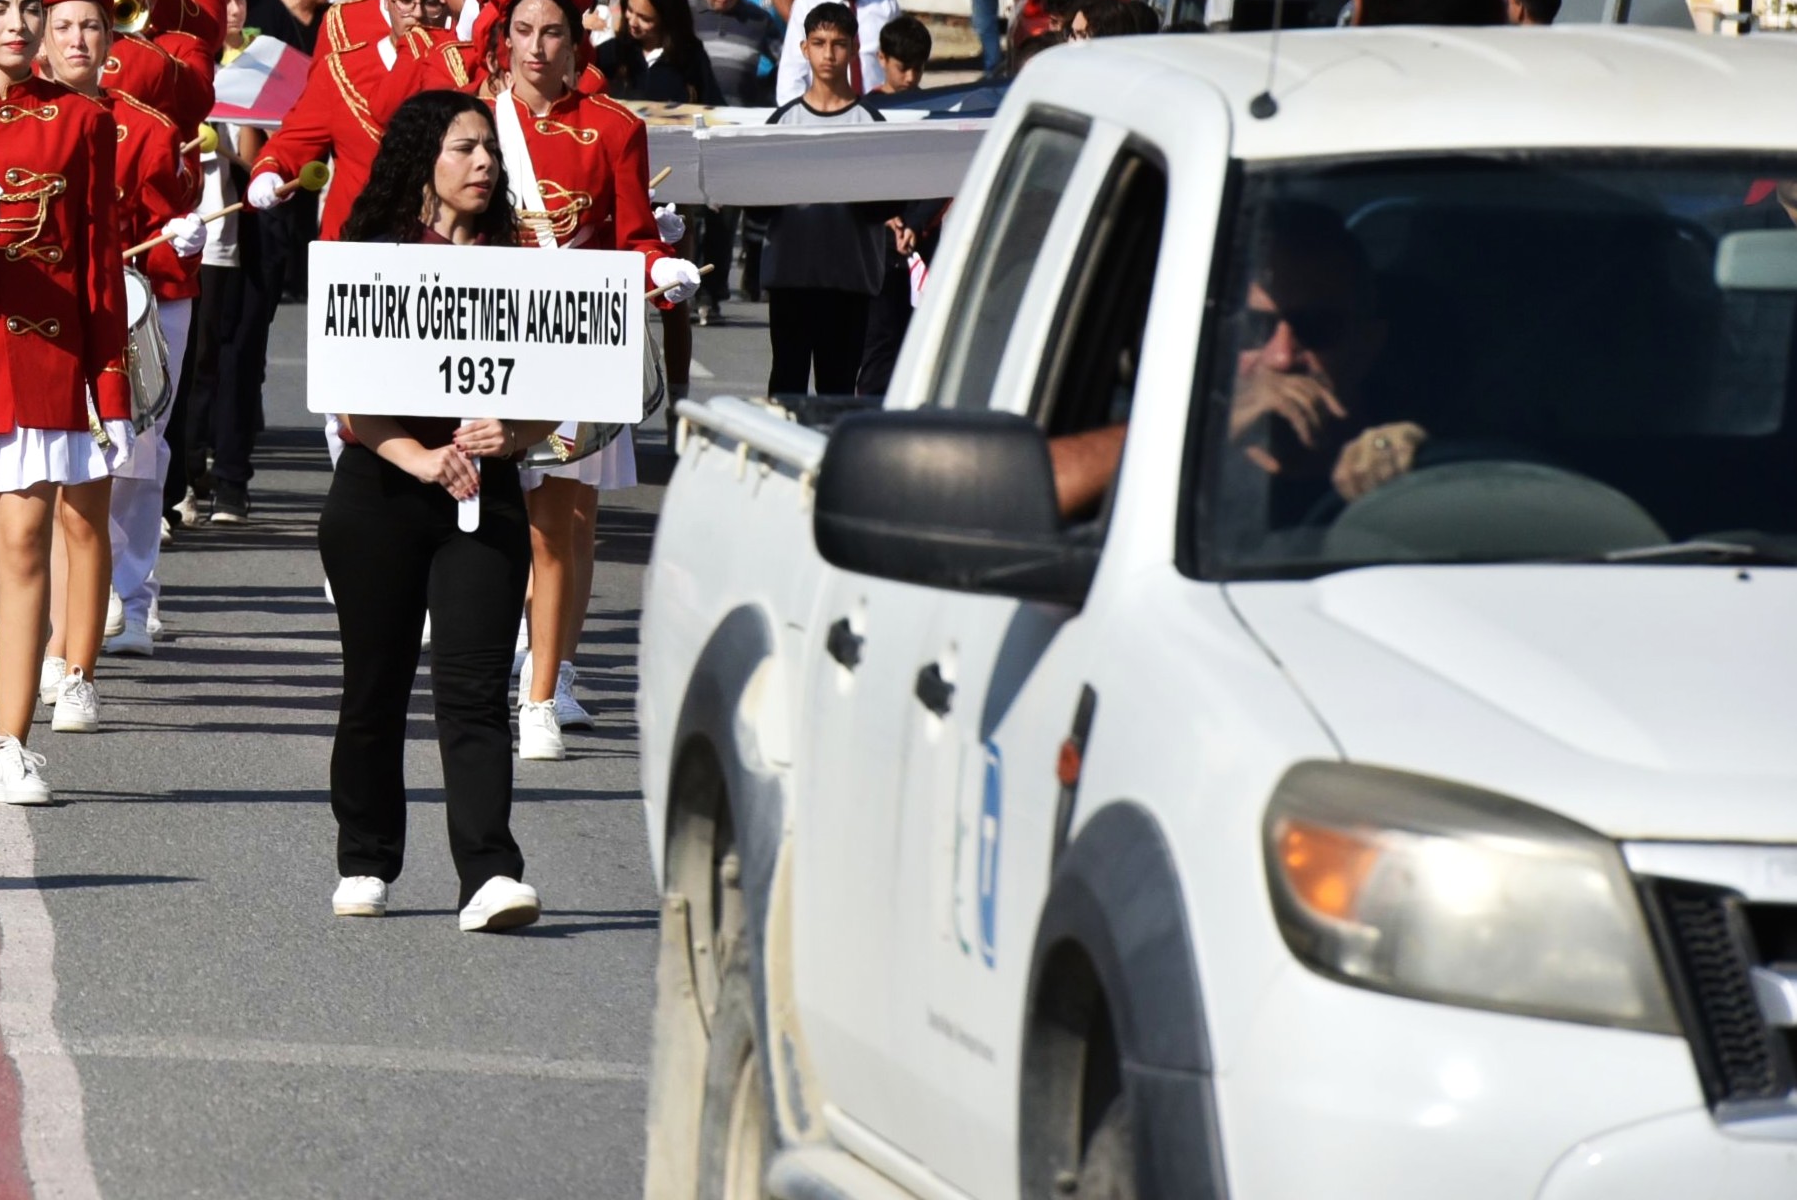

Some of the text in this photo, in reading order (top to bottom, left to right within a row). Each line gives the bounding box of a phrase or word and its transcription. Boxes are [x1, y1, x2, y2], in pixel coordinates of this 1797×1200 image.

[324, 272, 627, 346] ATATÜRK ÖĞRETMEN AKADEMİSİ
[439, 356, 515, 395] 1937
